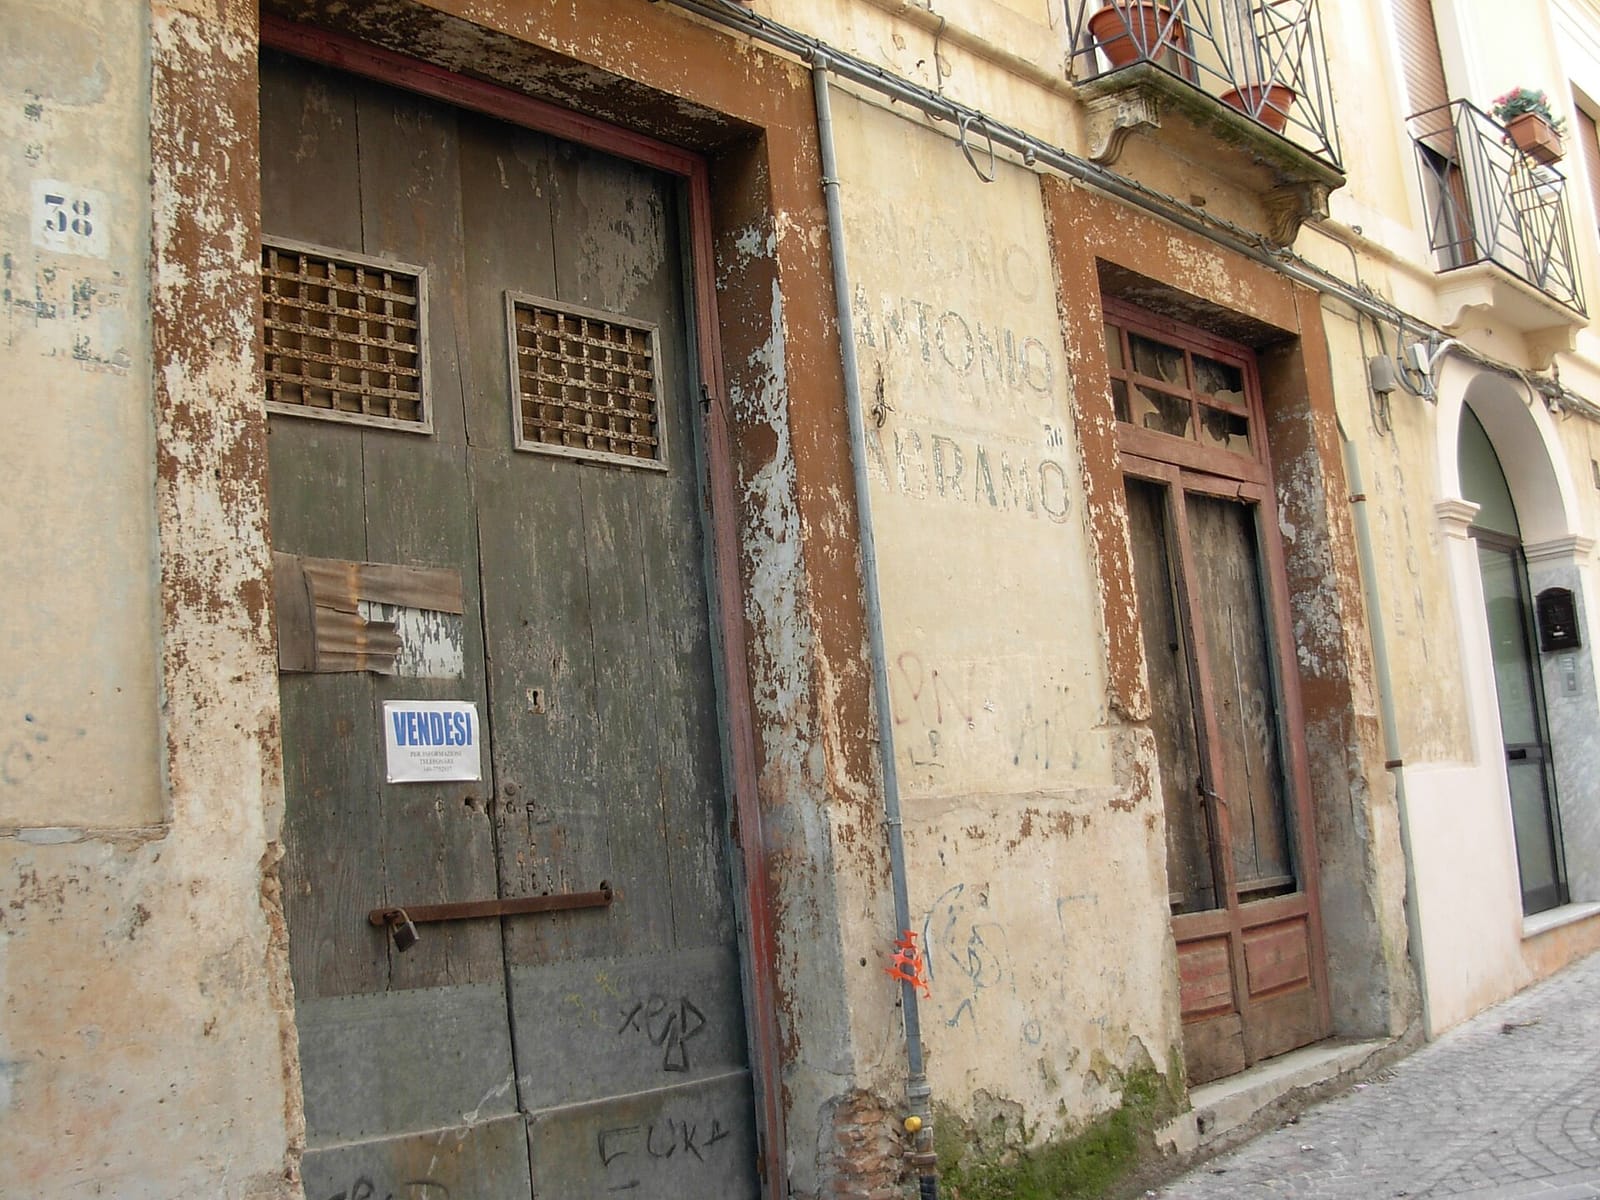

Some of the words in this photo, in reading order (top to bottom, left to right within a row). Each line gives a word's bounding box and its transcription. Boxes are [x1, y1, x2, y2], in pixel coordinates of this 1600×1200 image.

[44, 193, 94, 238] 38
[853, 282, 1053, 393] ANTONIO
[392, 711, 473, 746] VENDESI
